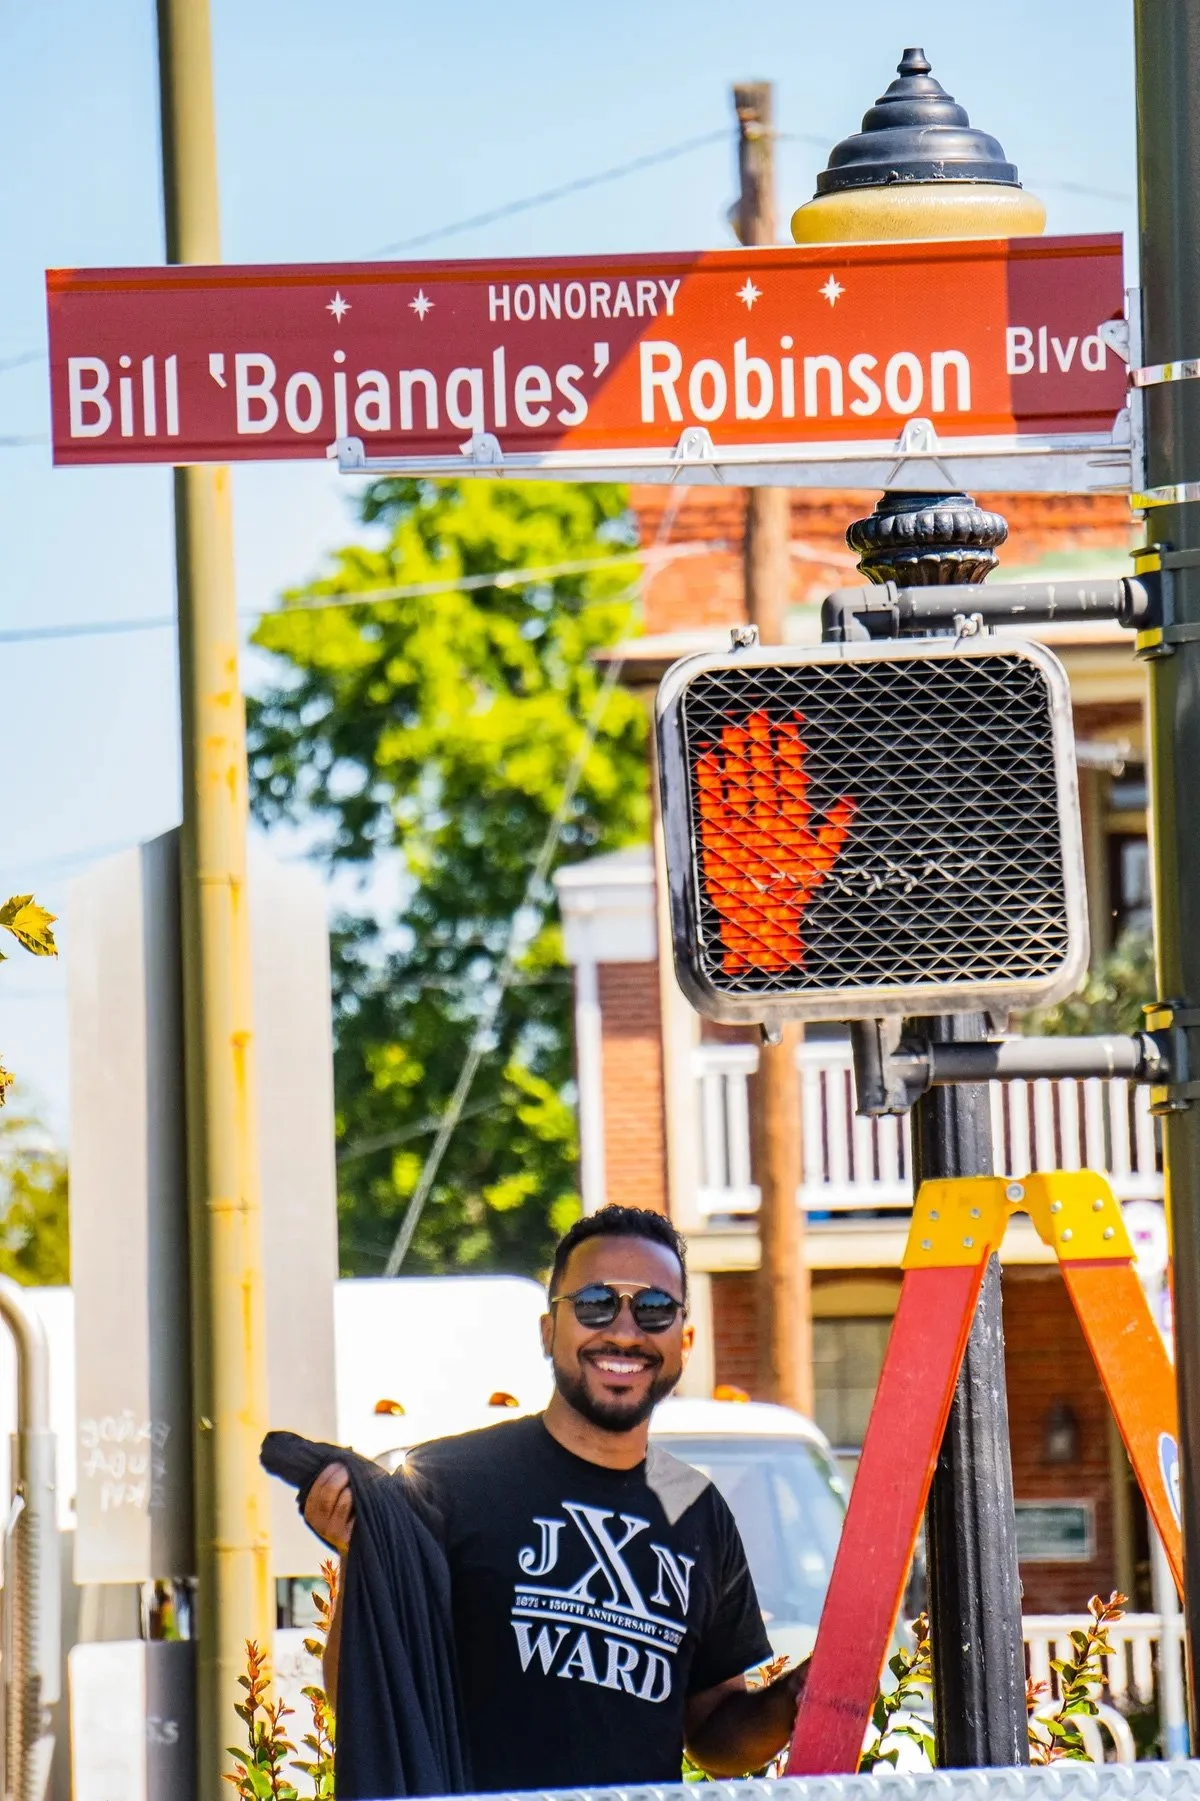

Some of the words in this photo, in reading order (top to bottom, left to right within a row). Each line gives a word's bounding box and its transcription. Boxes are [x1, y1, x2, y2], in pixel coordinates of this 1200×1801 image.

[488, 279, 681, 322] HONORARY
[67, 354, 180, 438] Bill
[639, 336, 972, 423] Robinson
[1005, 325, 1107, 375] Blvd
[518, 1501, 696, 1617] JXN
[549, 1599, 586, 1615] 150TH
[587, 1607, 657, 1636] ANNIVERSARY
[510, 1620, 672, 1703] WARD
